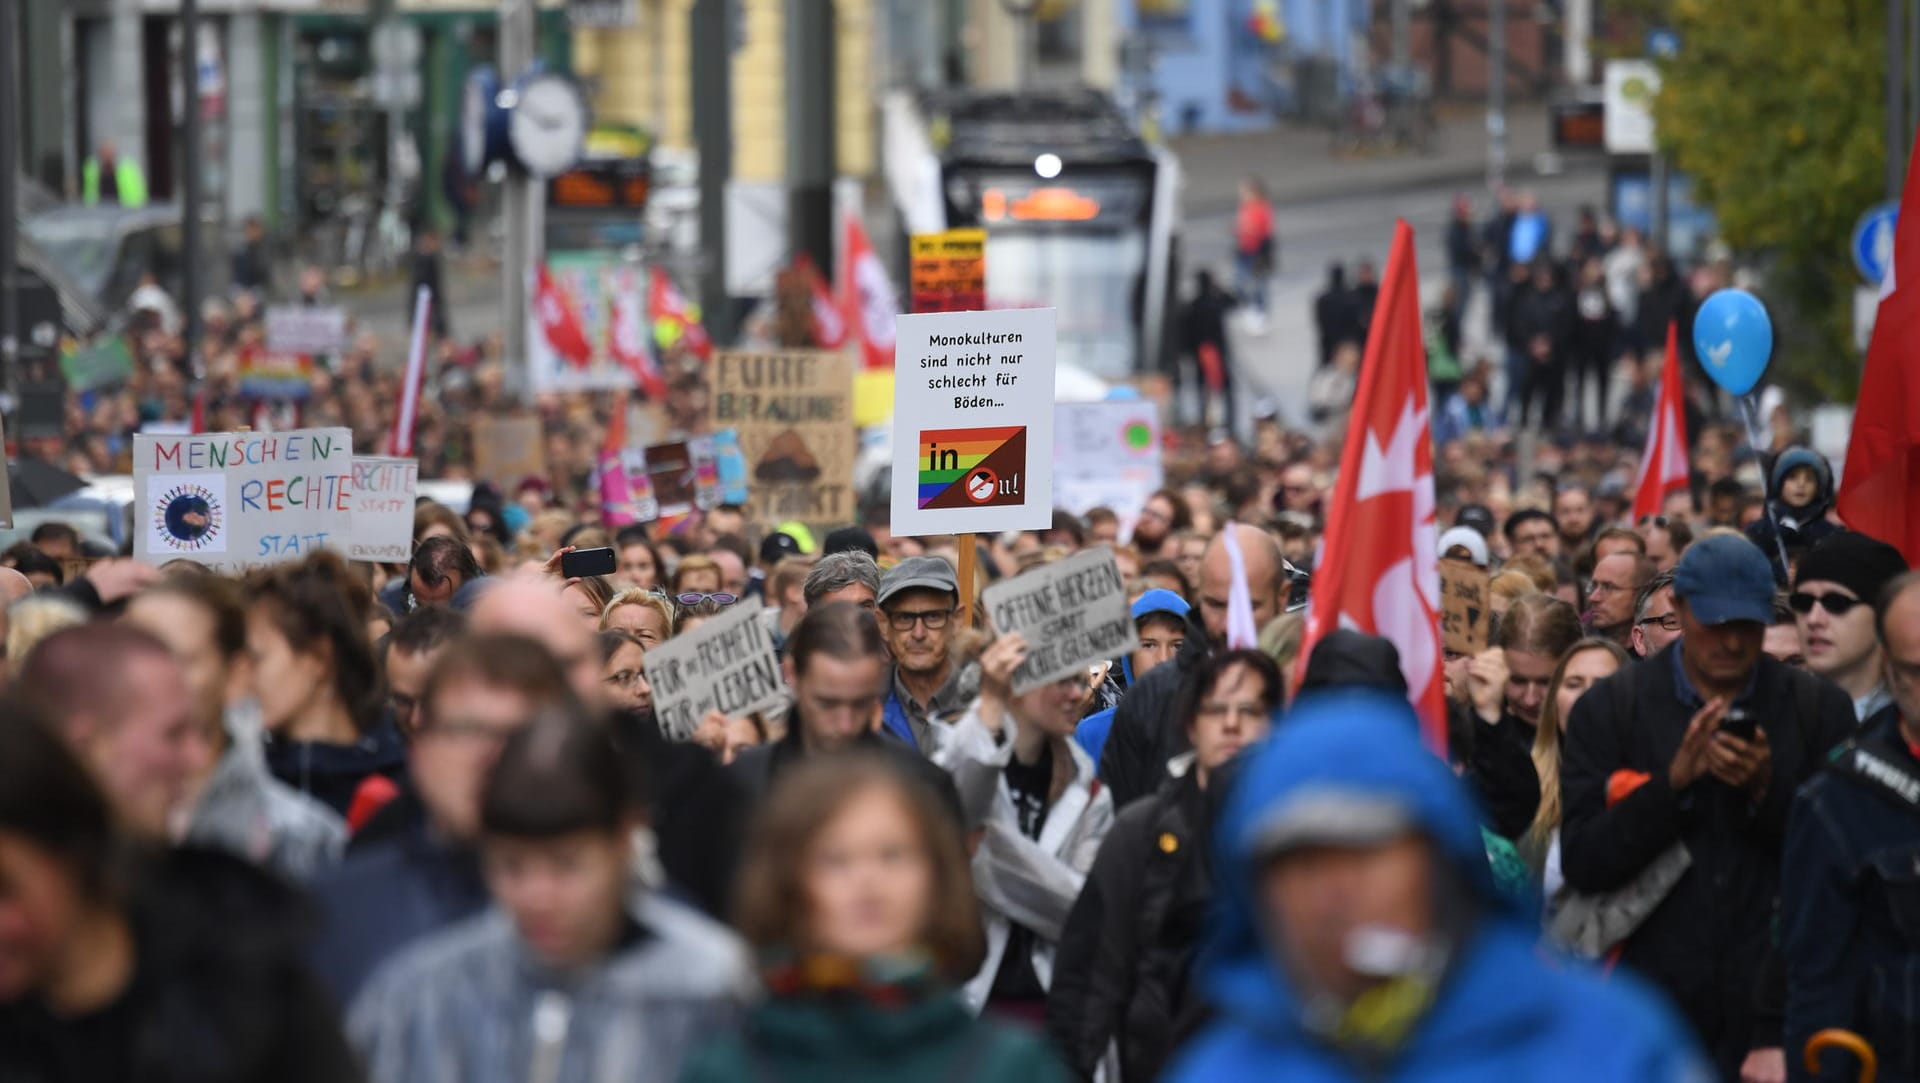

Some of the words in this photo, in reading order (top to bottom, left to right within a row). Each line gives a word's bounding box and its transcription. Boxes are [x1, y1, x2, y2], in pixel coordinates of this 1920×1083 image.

[929, 332, 1023, 347] Monokulturen
[920, 354, 948, 369] sind
[956, 353, 992, 367] nicht
[1000, 353, 1023, 365] nur
[928, 374, 987, 389] schlecht
[996, 373, 1018, 387] für
[953, 395, 1005, 409] Böden...
[930, 442, 959, 471] in
[240, 475, 353, 513] RECHTE
[258, 532, 330, 557] STATT
[1055, 559, 1124, 608] HERZEN
[649, 657, 687, 699] FÜR
[695, 612, 763, 678] FREIHEIT
[712, 653, 778, 714] LEBEN
